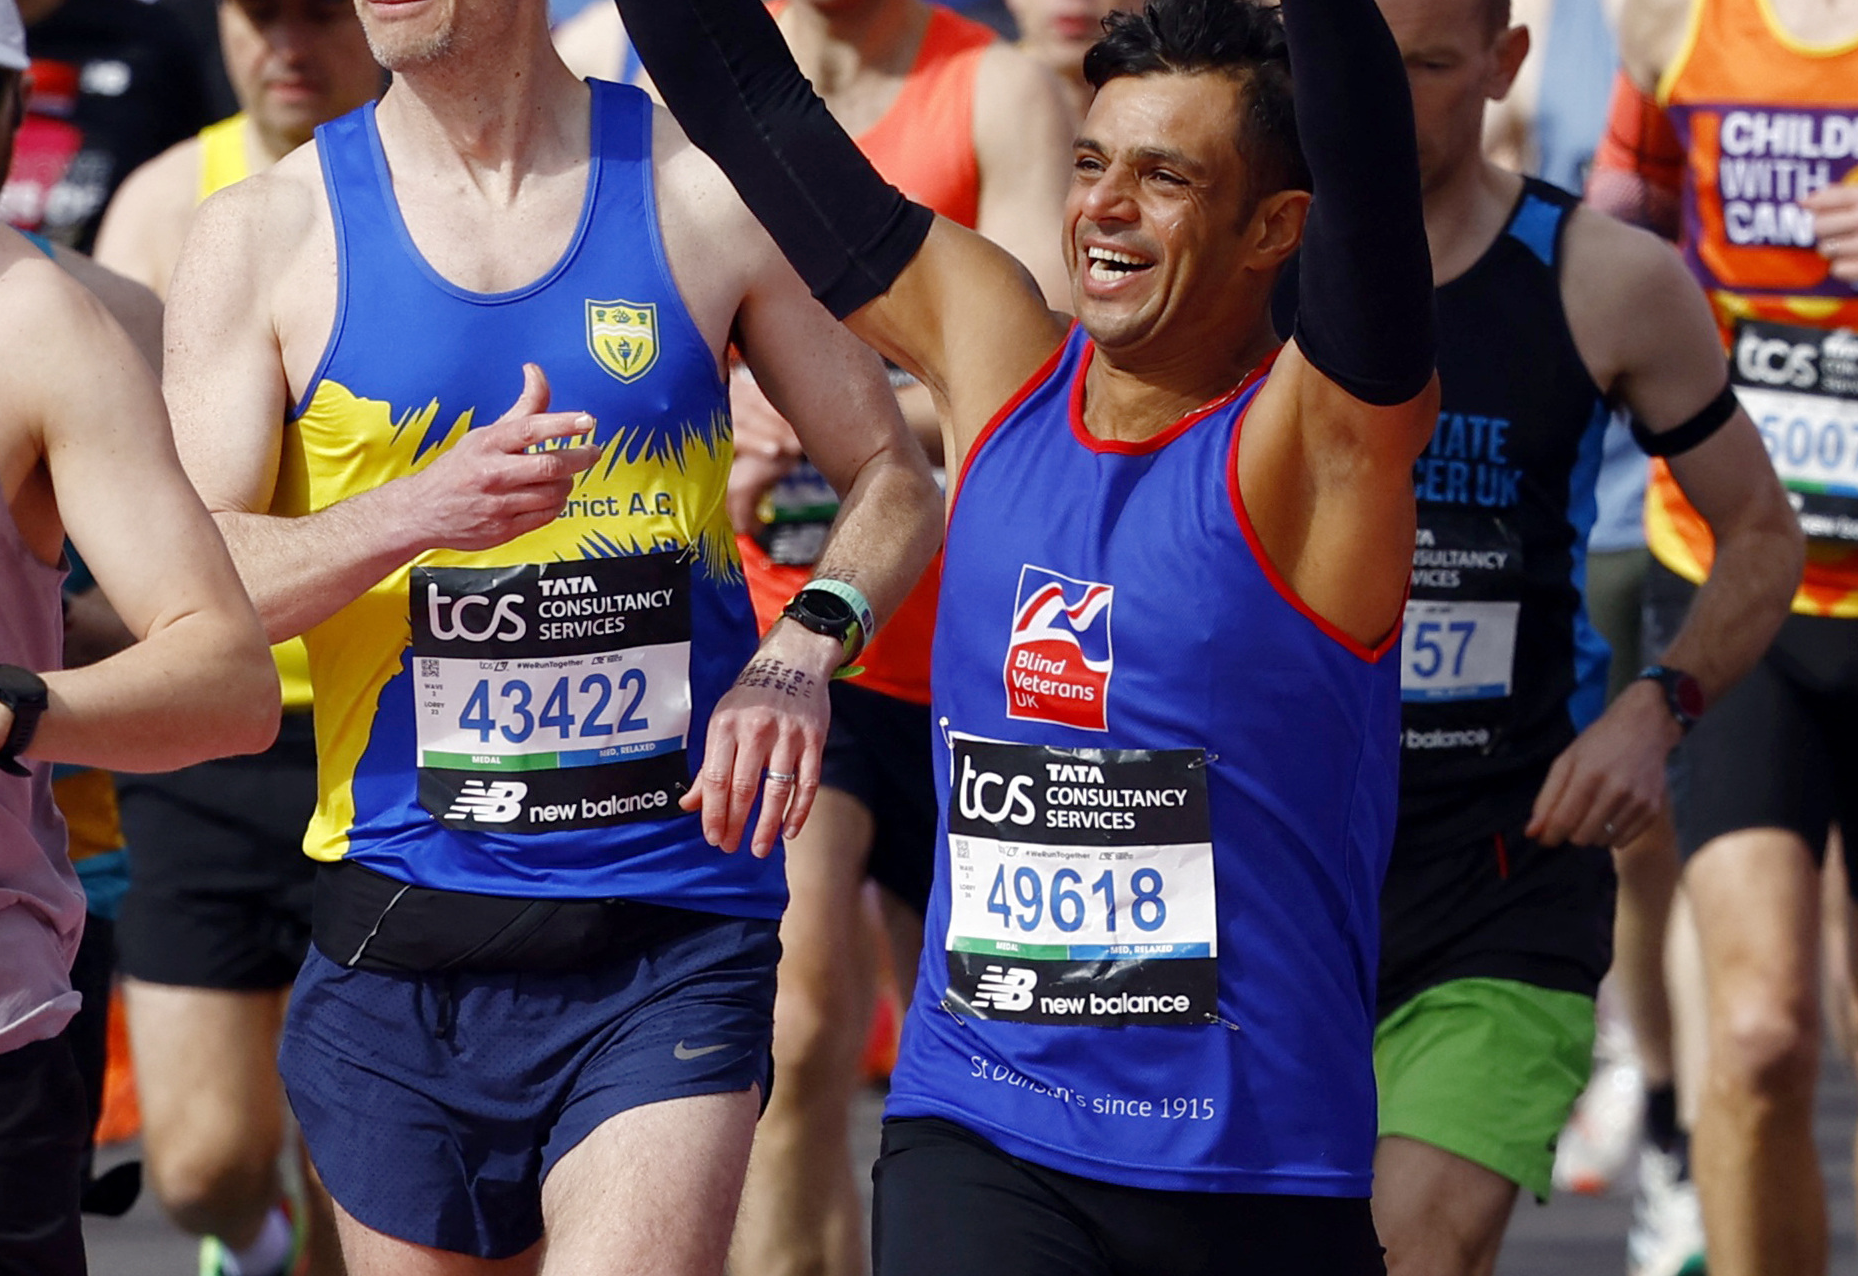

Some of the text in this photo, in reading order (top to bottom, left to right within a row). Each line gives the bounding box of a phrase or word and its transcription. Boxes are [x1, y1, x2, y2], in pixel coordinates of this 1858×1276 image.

[1719, 159, 1832, 202] WITH
[1723, 201, 1818, 248] CAN
[1736, 324, 1819, 388] tcs
[1430, 410, 1511, 465] TATE
[628, 492, 676, 517] A.C.
[1412, 550, 1509, 570] SULTANCY
[538, 575, 598, 597] TATA
[1411, 569, 1461, 588] VICES
[427, 581, 527, 643] tcs
[538, 588, 674, 619] CONSULTANCY
[538, 616, 626, 641] SERVICES
[517, 659, 584, 670] #WeRunTogether
[1015, 650, 1067, 675] Blind
[1012, 669, 1095, 701] Veterans
[458, 668, 649, 744] 43422
[1015, 691, 1039, 709] UK
[471, 755, 502, 765] MEDAL
[599, 742, 656, 758] MED, RELAXED
[1045, 763, 1106, 784] TATA
[958, 754, 1037, 826] tcs
[1045, 786, 1189, 808] CONSULTANCY
[529, 789, 669, 824] new balance
[1045, 810, 1137, 831] SERVICES
[1025, 850, 1091, 861] #WeRunTogether
[987, 863, 1167, 933] 49618
[995, 941, 1020, 952] MEDAL
[1134, 943, 1173, 954] RELAXED
[1040, 992, 1190, 1015] new balance
[971, 1055, 989, 1080] St
[1092, 1094, 1152, 1118] since
[1159, 1097, 1215, 1121] 1915
